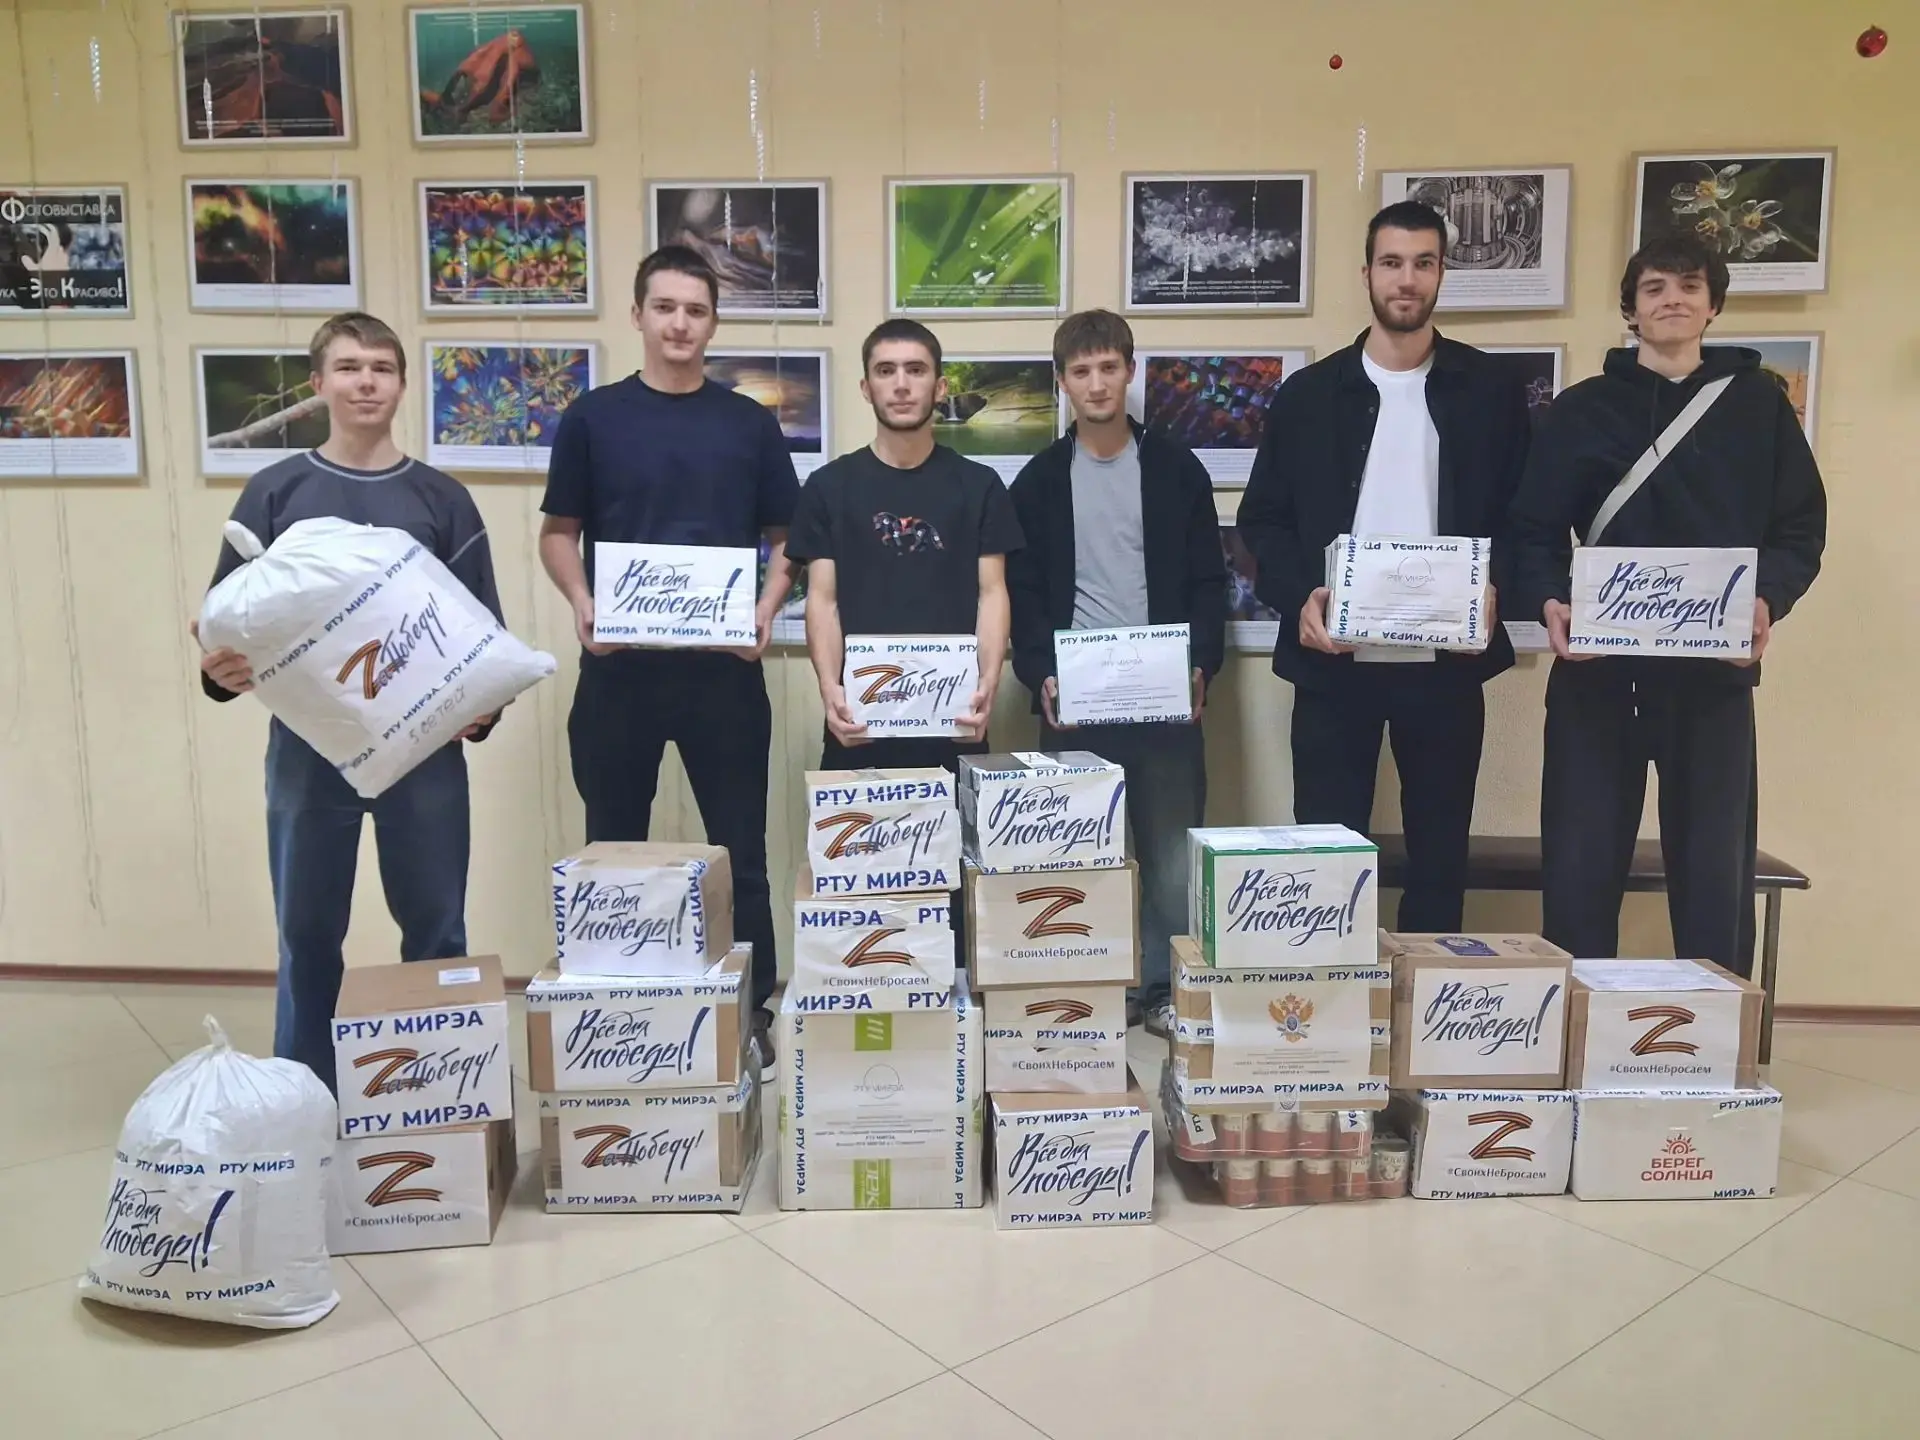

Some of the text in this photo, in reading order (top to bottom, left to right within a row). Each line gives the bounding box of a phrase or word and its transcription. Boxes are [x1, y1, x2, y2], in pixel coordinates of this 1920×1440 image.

[1392, 543, 1433, 551] МИРЭА
[1344, 565, 1354, 587] РТУ
[1471, 564, 1479, 584] РТУ
[1468, 599, 1478, 639] МИРЭА
[259, 581, 383, 683] РТУ МИРЭА РТУ МИРЭА
[596, 626, 638, 634] МИРЭА
[672, 627, 712, 637] МИРЭА
[725, 630, 745, 638] РТУ
[1060, 637, 1078, 645] РТУ
[1081, 634, 1118, 644] МИРЭА
[1151, 630, 1188, 638] МИРЭА
[1382, 632, 1423, 642] МИРЭА
[1569, 637, 1730, 648] РТУ МИРЭА РТУ МИРЭА
[382, 634, 495, 740] РТУ МИРЭА РТУ МИРЭА
[889, 719, 928, 727] МИРЭА
[1098, 716, 1135, 725] МИРЭА
[982, 768, 1058, 781] МИРЭА РТУ
[816, 781, 948, 806] РТУ МИРЭА
[1013, 857, 1115, 872] РТУ МИРЭА РТУ
[816, 869, 947, 892] РТУ МИРЭА
[801, 910, 883, 927] МИРЭА
[1016, 886, 1094, 939] Z
[1003, 947, 1108, 959] #СвоихНеБросаем
[1189, 971, 1350, 984] МИРЭА РТУ МИРЭА РТУ
[548, 992, 594, 1002] МИРЭА
[610, 990, 633, 999] РТУ
[638, 988, 683, 998] МИРЭА
[694, 987, 716, 996] РТУ
[796, 992, 950, 1010] МИРЭА РТУ
[337, 1010, 484, 1041] РТУ МИРЭА
[1627, 1006, 1700, 1056] Z
[1037, 1030, 1106, 1040] РТУ МИРЭА
[957, 1033, 966, 1055] РТУ
[1012, 1060, 1115, 1072] #СвоихНеБросаем
[956, 1059, 966, 1103] МИРЭА
[1194, 1083, 1380, 1095] РТУ МИРЭА РТУ МИРЭА РТУ
[560, 1096, 717, 1107] РТУ МИРЭА РТУ МИРЭА
[1458, 1093, 1560, 1103] РТУ РТУ
[1719, 1101, 1741, 1111] РТУ
[345, 1102, 491, 1134] РТУ МИРЭА
[796, 1049, 805, 1195] РТУ МИРЭА РТУ МИРЭА
[1017, 1110, 1125, 1126] РТУ МИРЭА РТУ
[956, 1116, 964, 1139] РТУ
[1468, 1111, 1536, 1160] Z
[155, 1162, 248, 1174] МИРЭА РТУ
[955, 1141, 964, 1184] МИРЭА
[1651, 1158, 1706, 1169] БЕРЕГ
[357, 1151, 444, 1207] Z
[1641, 1170, 1713, 1182] СОЛНЦА
[568, 1194, 723, 1204] РТУ МИРЭА РТУ МИРЭА
[1431, 1190, 1452, 1198] РТУ
[1714, 1188, 1756, 1198] МИРЭА
[1011, 1212, 1115, 1223] РТУ МИРЭА РТУ
[106, 1279, 275, 1301] РТУ МИРЭА РТУ МИРЭА
